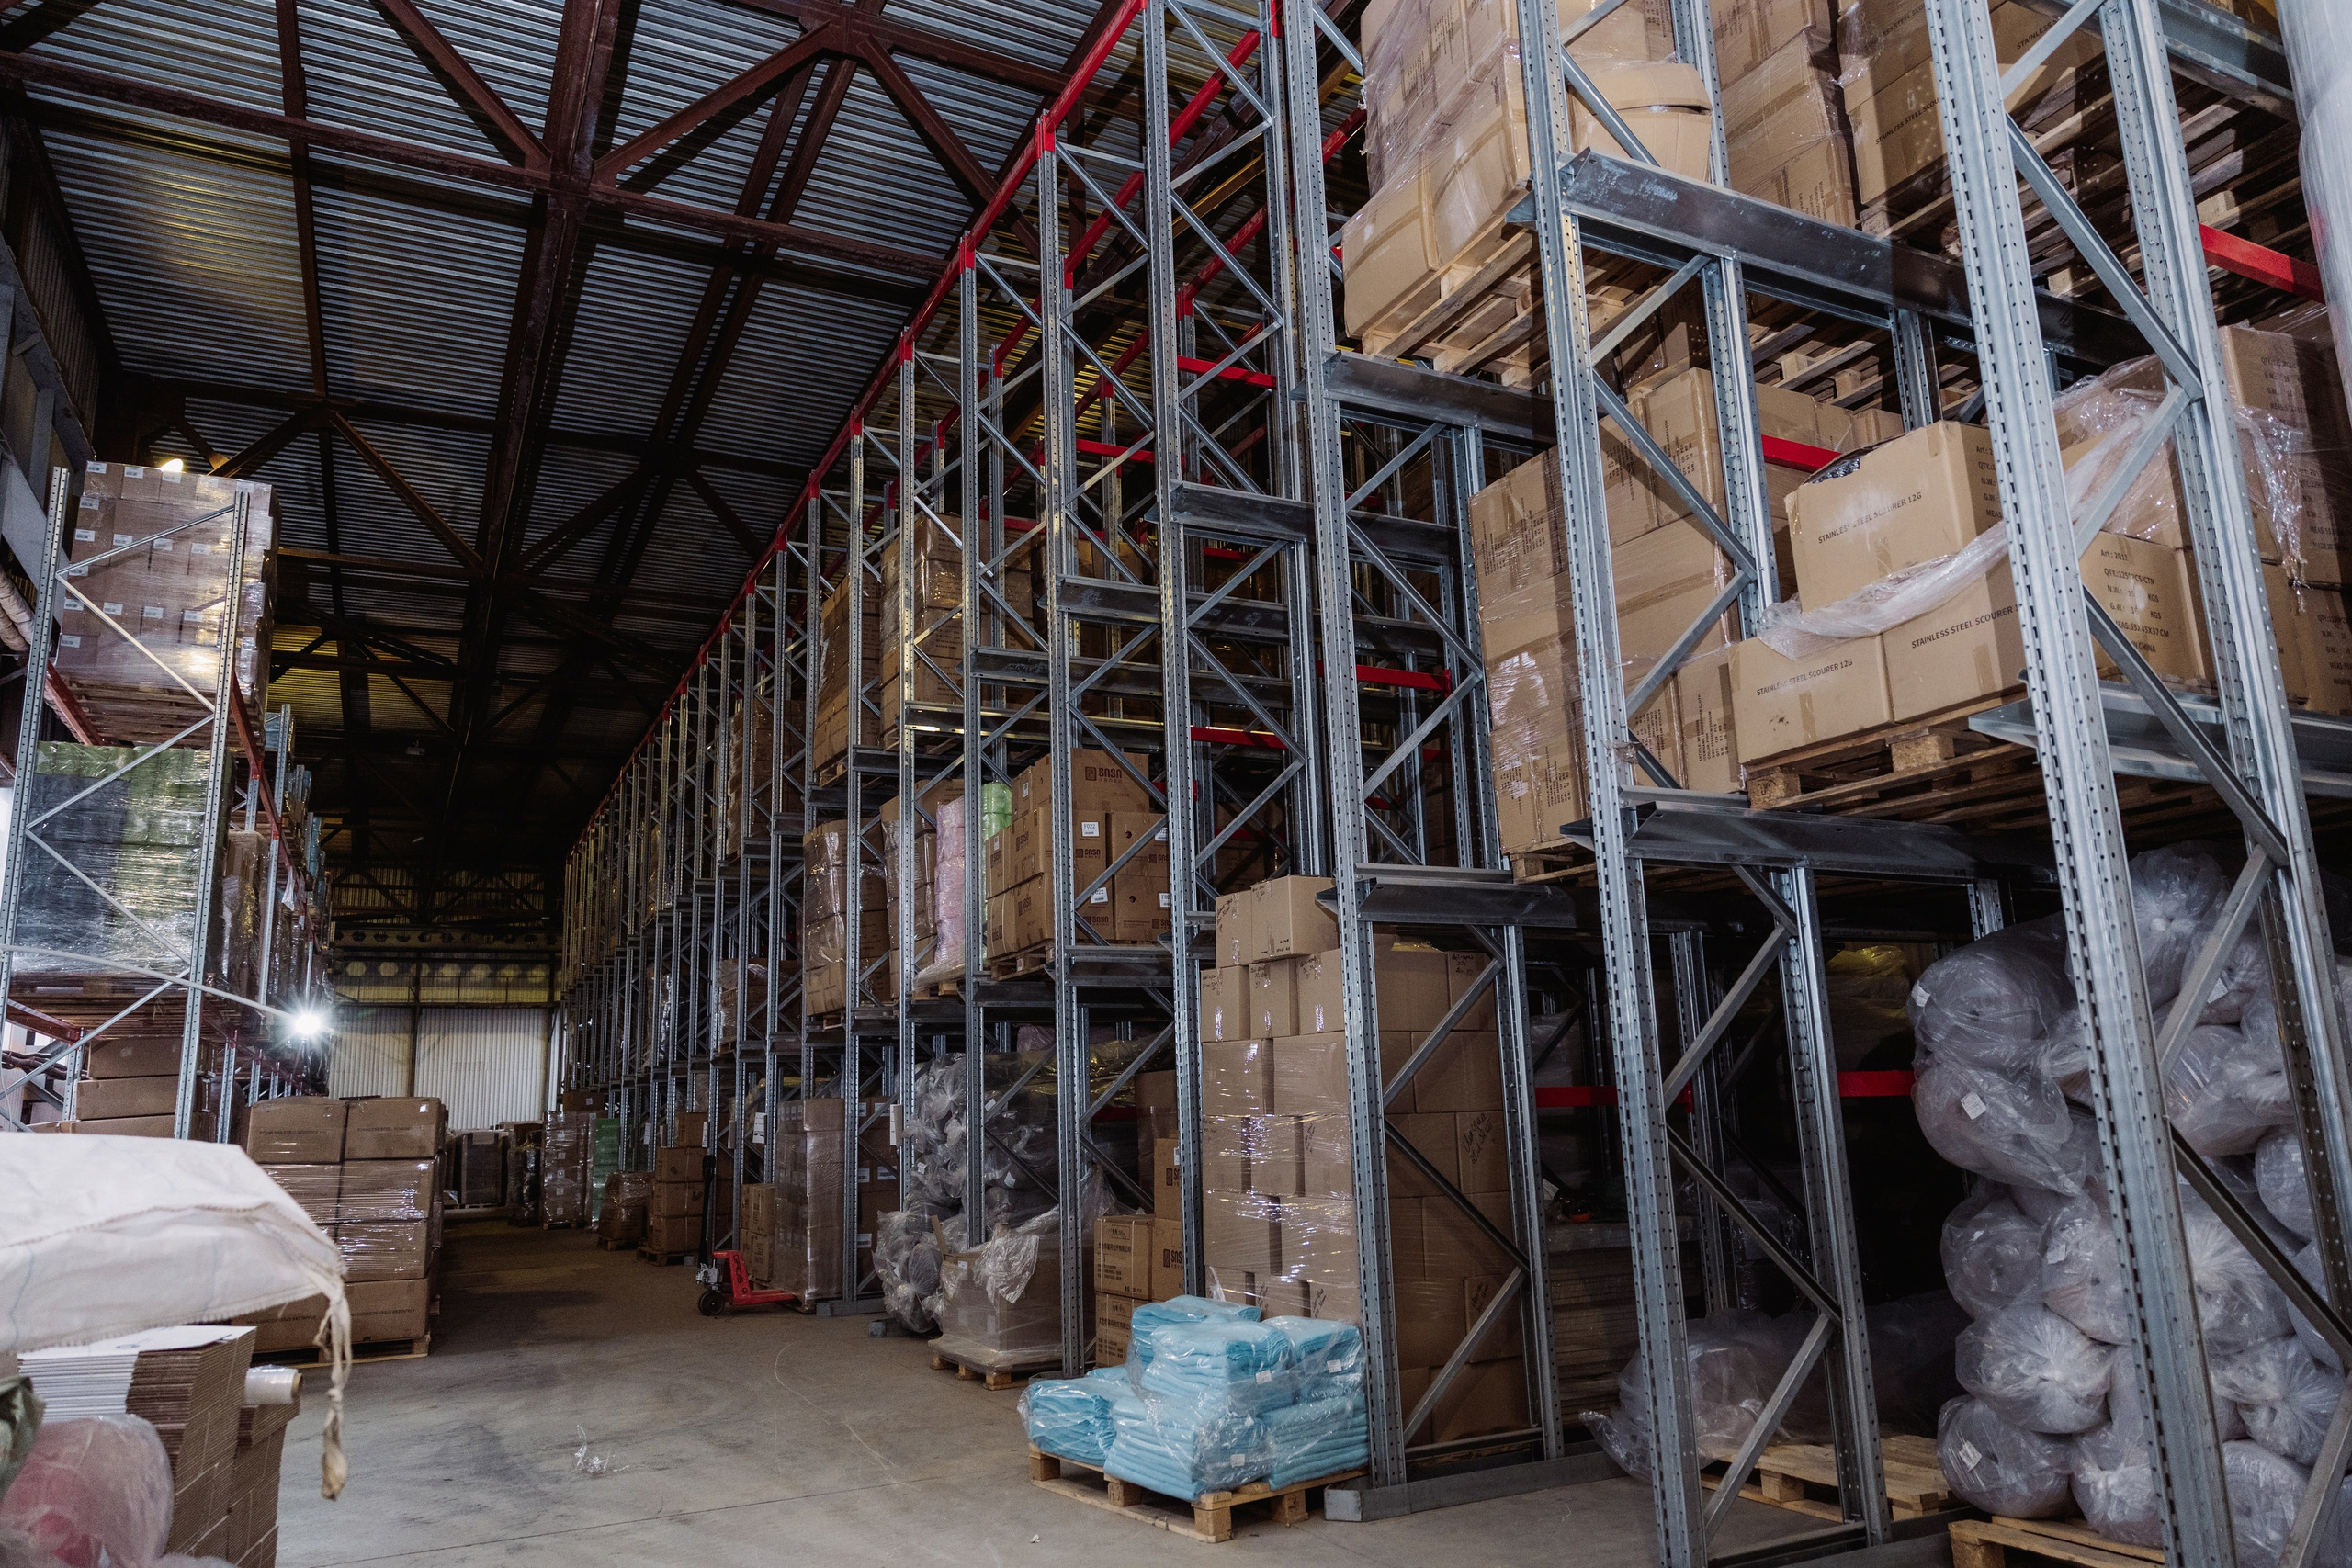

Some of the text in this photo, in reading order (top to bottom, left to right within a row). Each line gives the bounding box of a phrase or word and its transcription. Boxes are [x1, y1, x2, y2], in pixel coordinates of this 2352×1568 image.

[2017, 22, 2052, 50] STAINLESS
[1876, 120, 1904, 144] STAINLESS
[1905, 109, 1922, 125] STEEL
[1908, 492, 1922, 503] 12G
[2148, 593, 2159, 603] KGS
[2150, 611, 2161, 619] KGS
[1911, 606, 2013, 649] STAINLESS STEEL SCOURER
[2160, 627, 2169, 637] CM
[1790, 674, 1807, 685] STEEL
[1808, 663, 1838, 679] SCOURER
[1840, 659, 1853, 669] 12G
